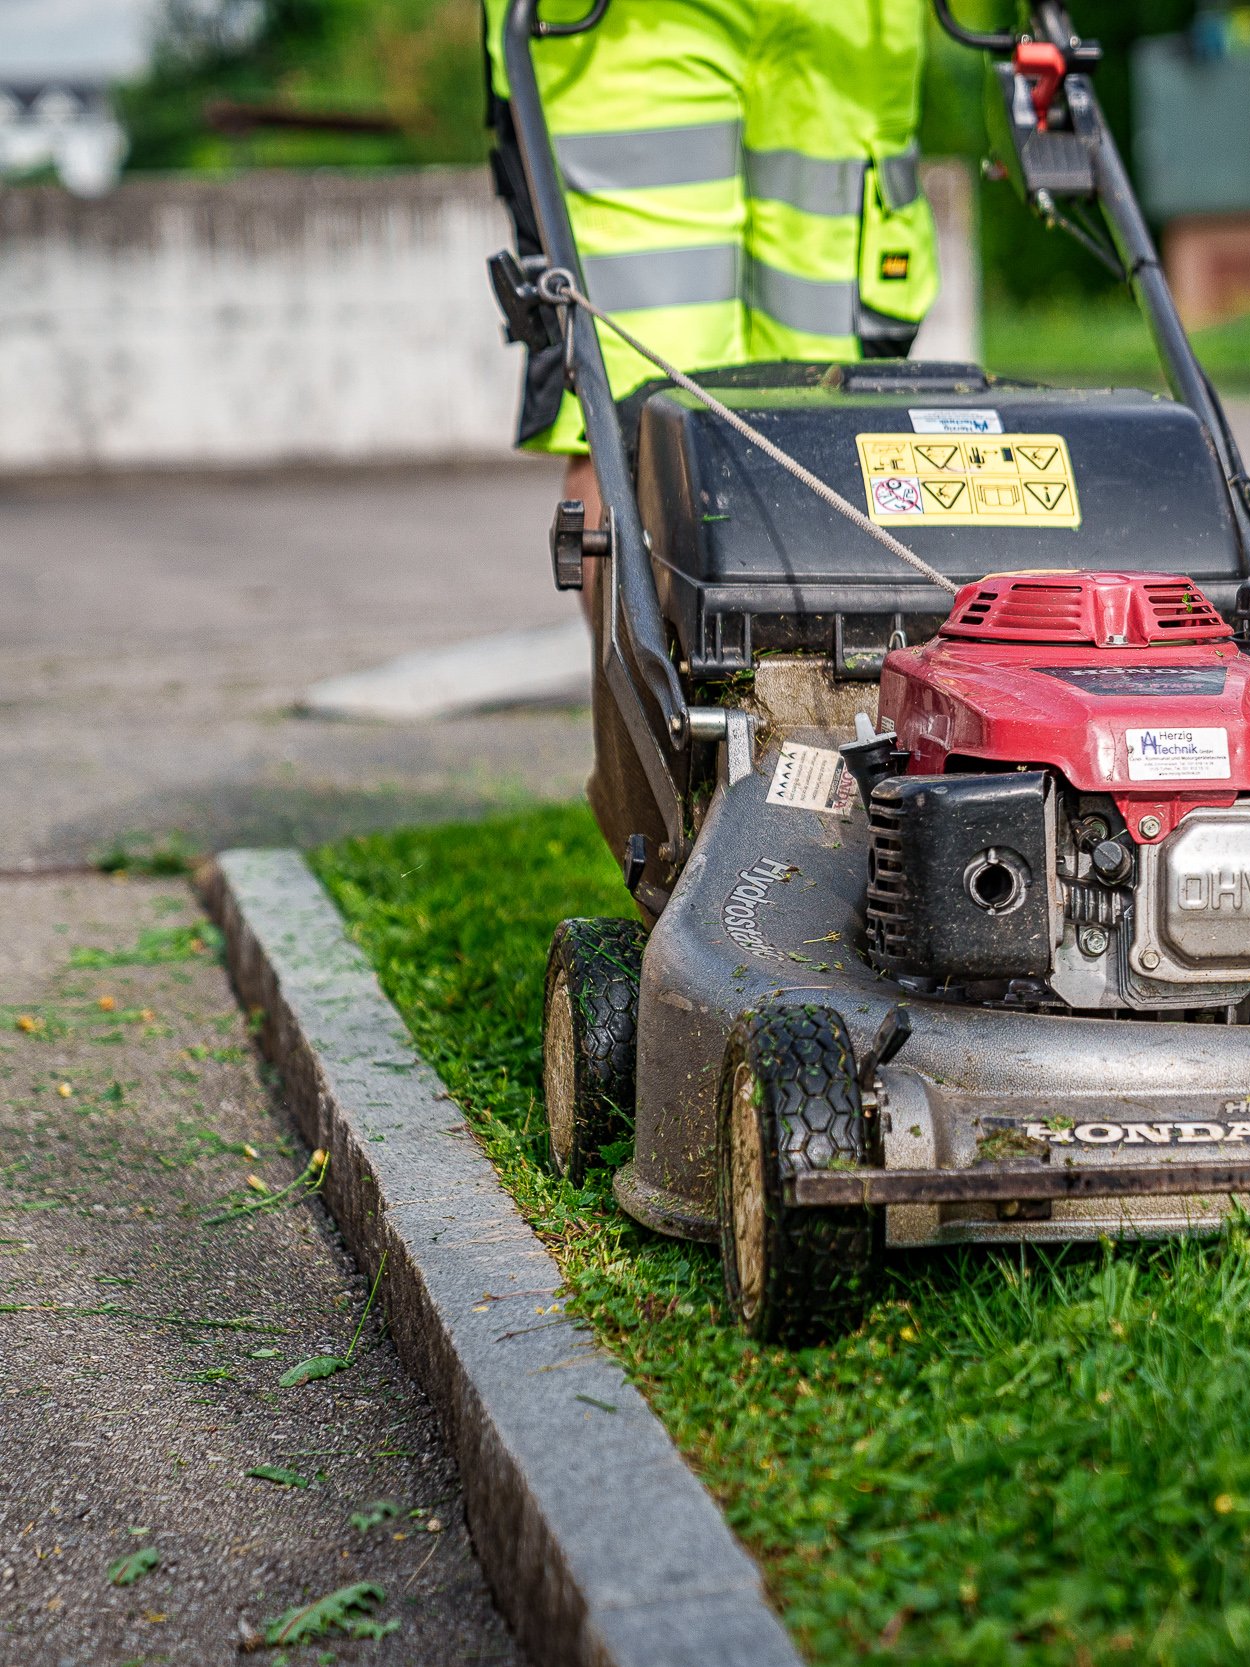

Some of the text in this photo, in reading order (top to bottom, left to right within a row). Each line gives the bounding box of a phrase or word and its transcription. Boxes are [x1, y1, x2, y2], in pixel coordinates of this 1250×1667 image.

[1069, 668, 1206, 676] HONDA
[1160, 731, 1193, 742] Herzig
[1156, 744, 1198, 755] Technik
[834, 767, 854, 810] ONDA
[724, 857, 788, 961] Hydrostatic
